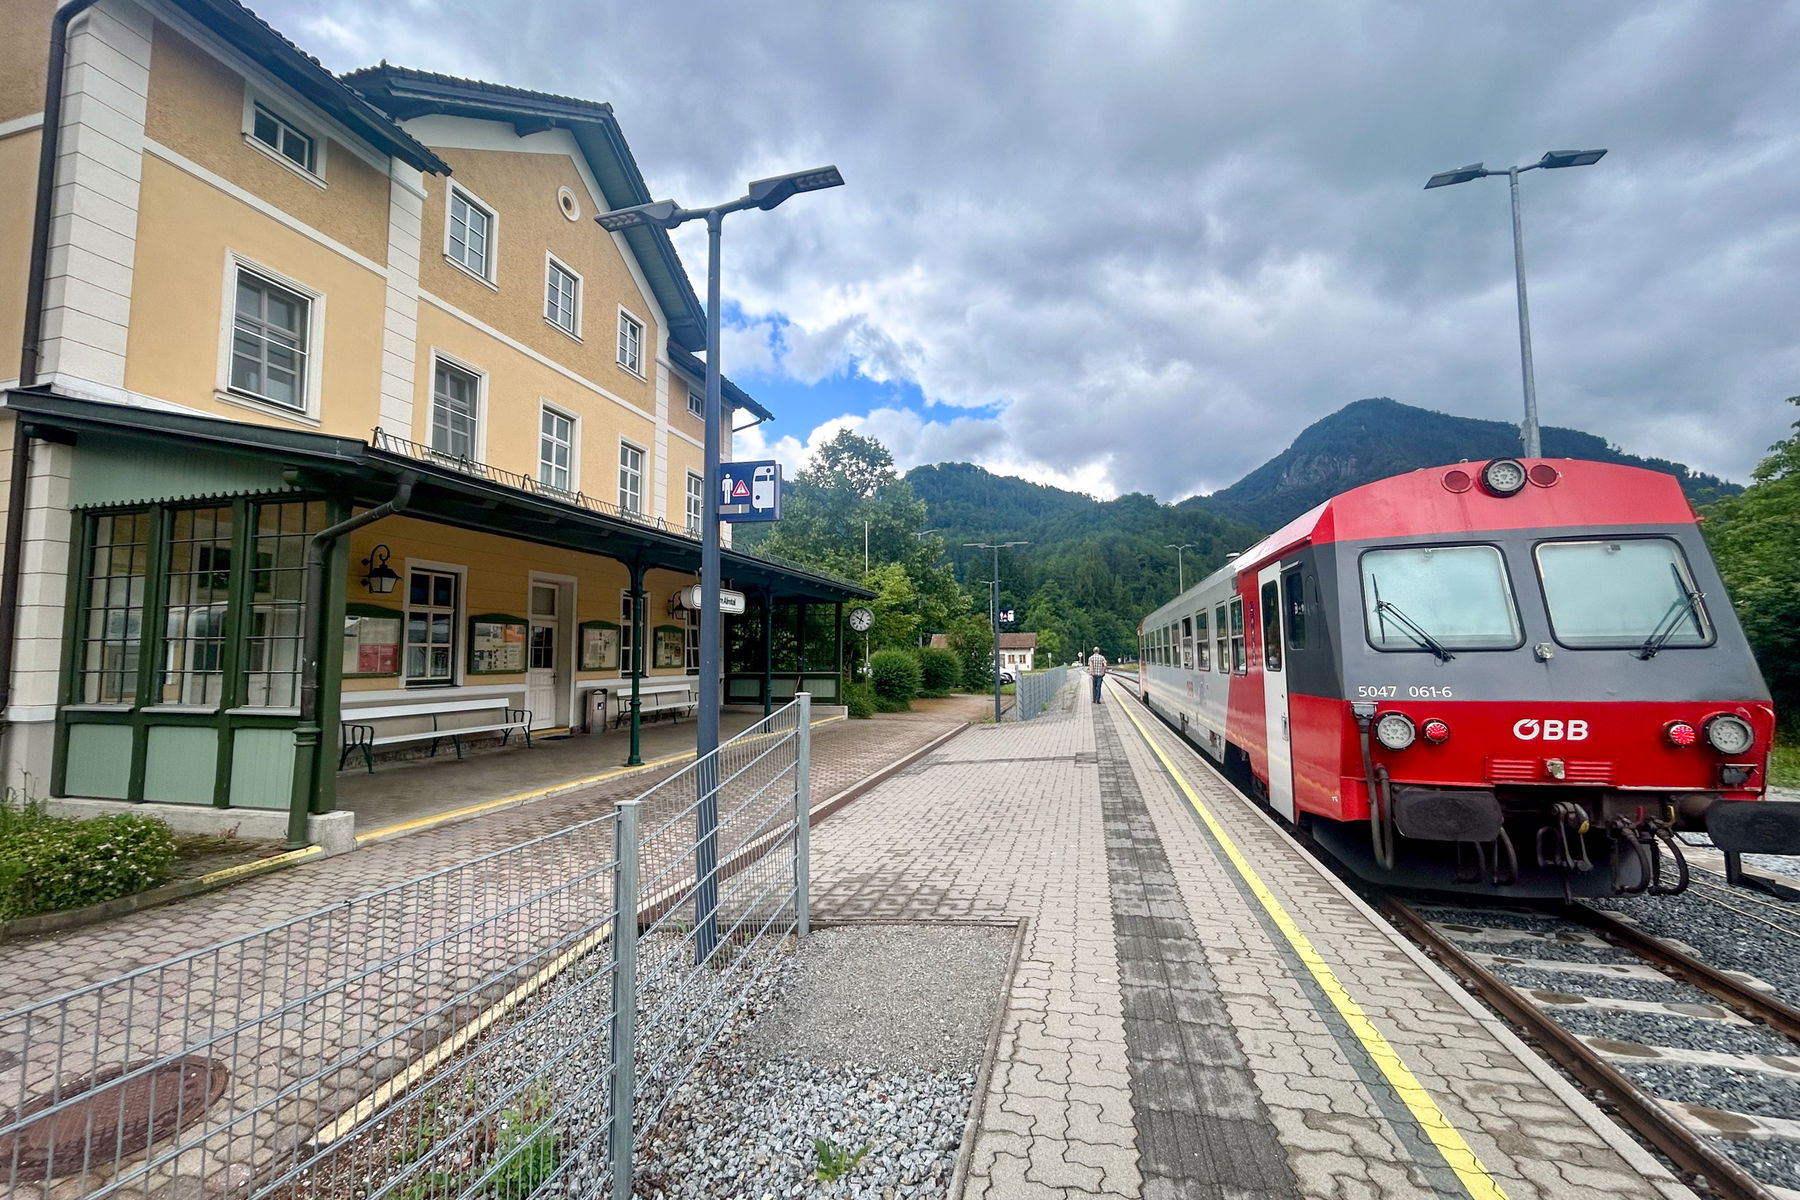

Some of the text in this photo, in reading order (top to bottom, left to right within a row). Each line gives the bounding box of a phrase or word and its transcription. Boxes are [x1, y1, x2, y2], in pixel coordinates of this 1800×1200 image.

[1358, 685, 1453, 698] 5047 061-6
[1512, 718, 1589, 741] ÖBB
